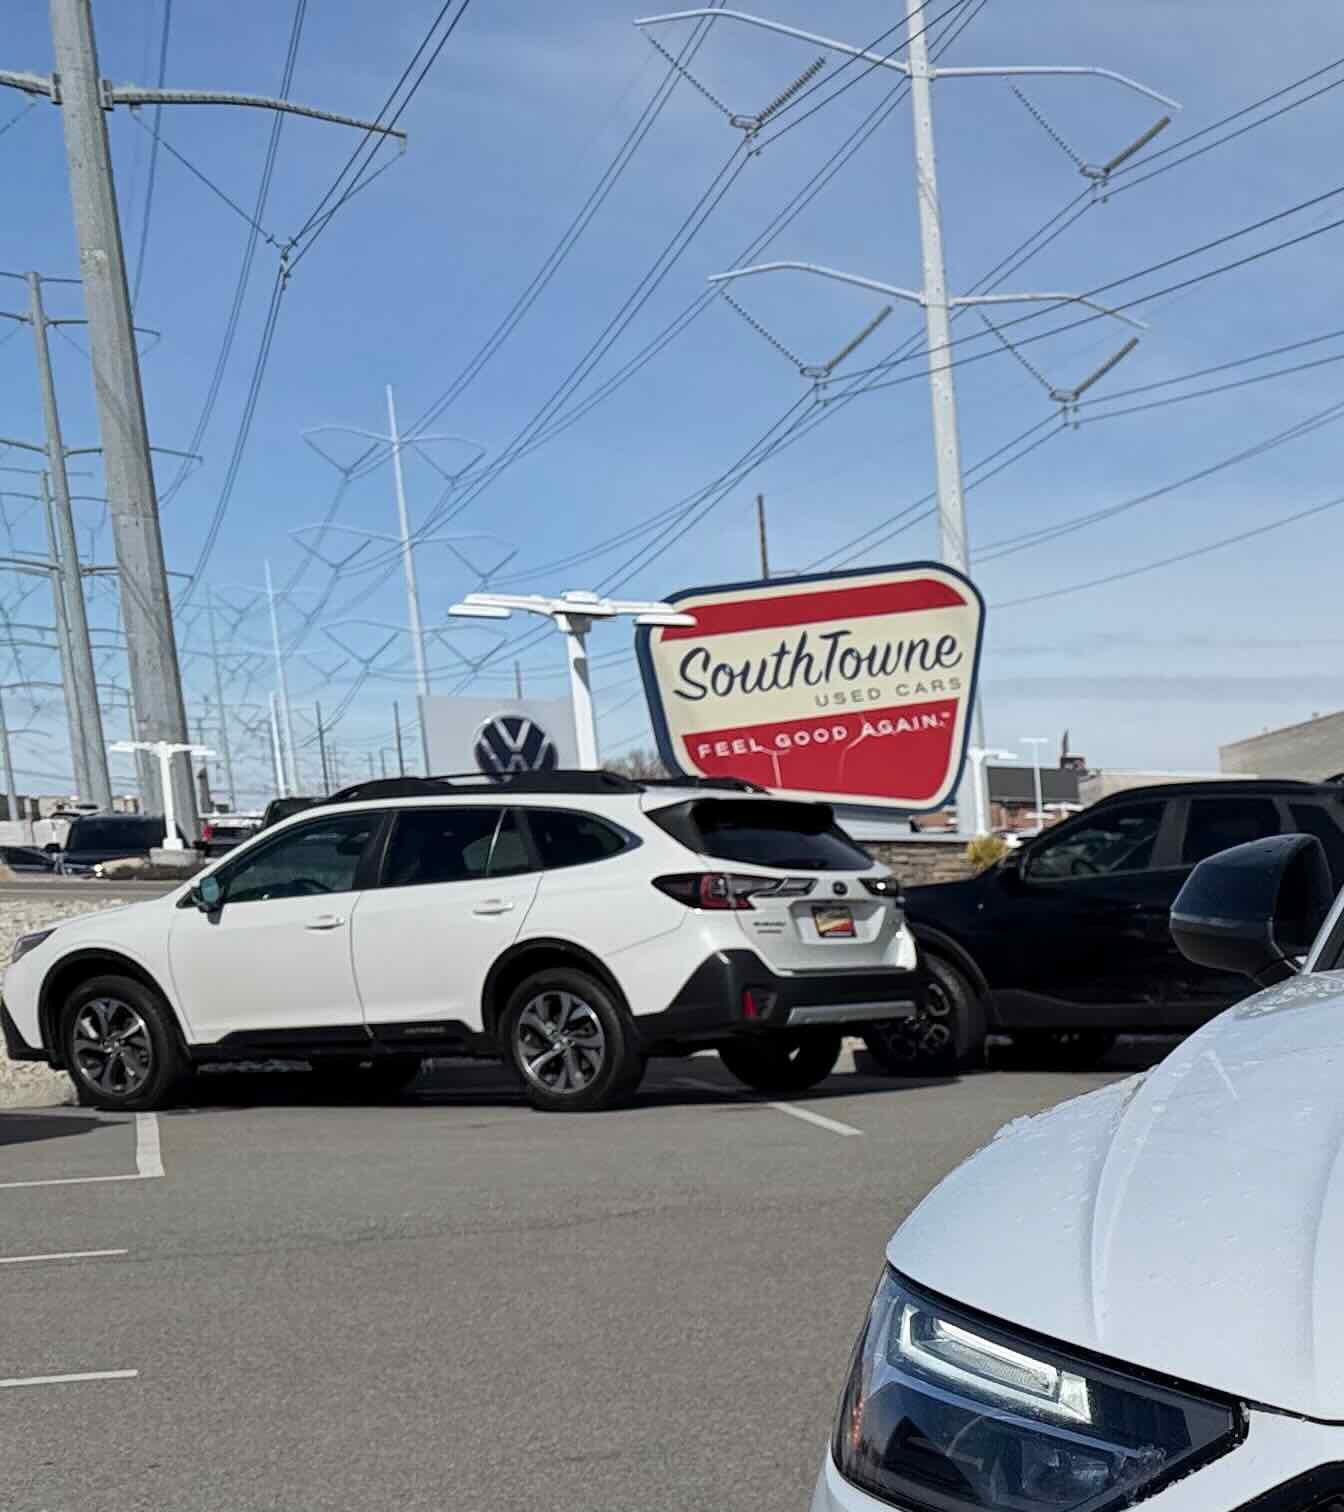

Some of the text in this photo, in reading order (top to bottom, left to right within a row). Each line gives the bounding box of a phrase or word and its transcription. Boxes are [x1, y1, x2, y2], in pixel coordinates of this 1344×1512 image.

[673, 630, 963, 701] SouthTowne
[815, 677, 962, 707] USED CARS
[698, 737, 763, 759] FEEL
[774, 725, 848, 748] GOOD
